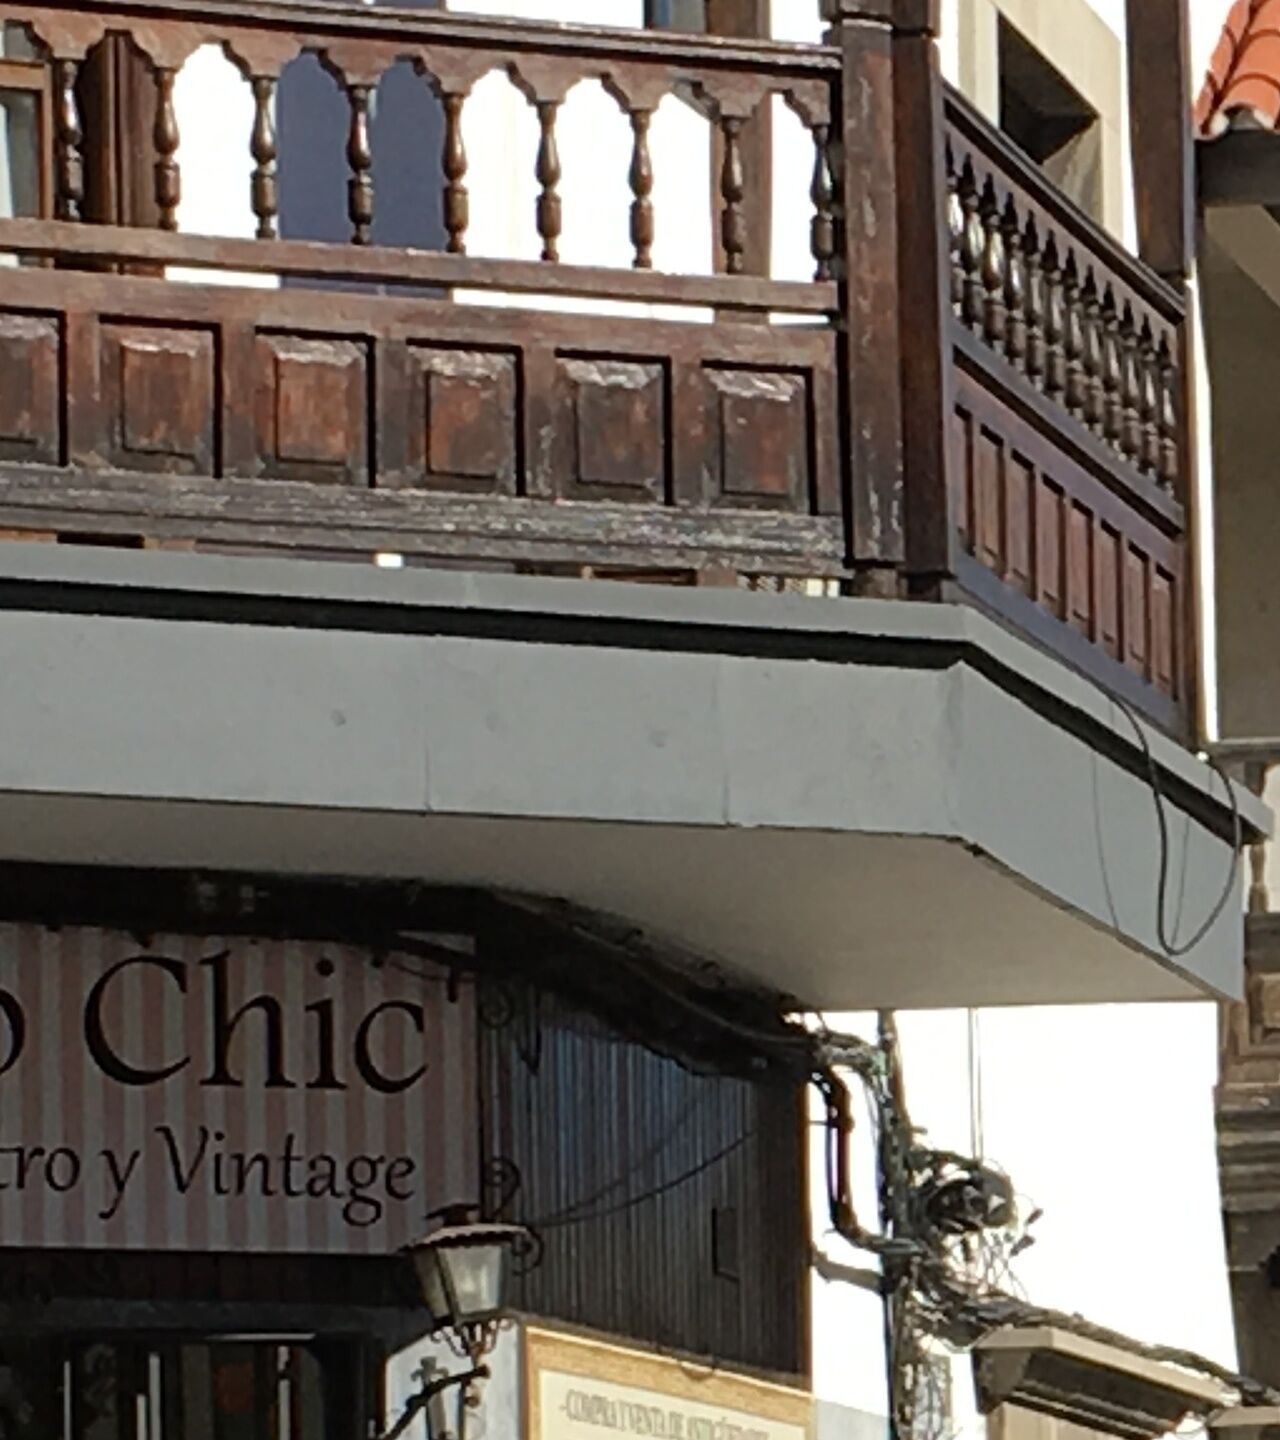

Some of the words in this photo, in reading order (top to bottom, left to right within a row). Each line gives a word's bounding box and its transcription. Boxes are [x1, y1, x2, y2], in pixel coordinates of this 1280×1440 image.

[84, 949, 430, 1094] Chic
[98, 1148, 141, 1220] y
[155, 1126, 417, 1227] Vintage
